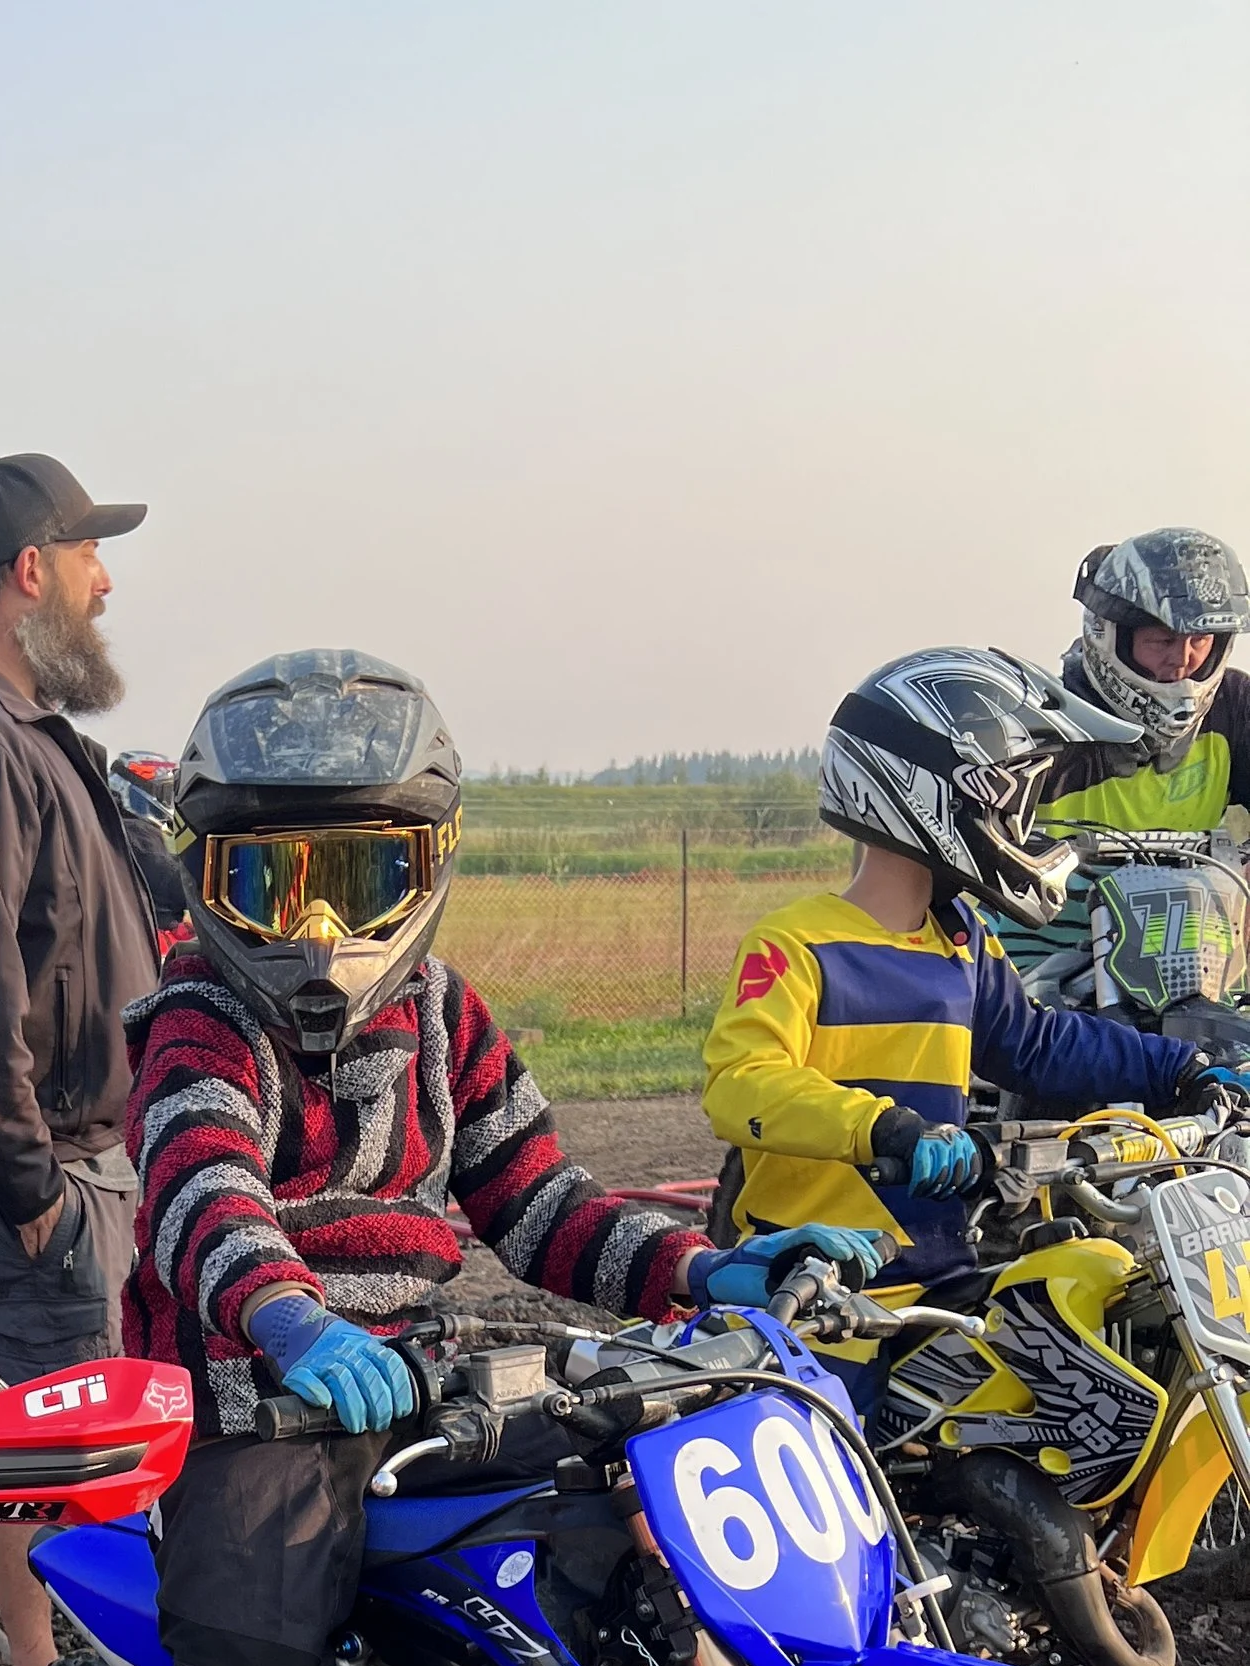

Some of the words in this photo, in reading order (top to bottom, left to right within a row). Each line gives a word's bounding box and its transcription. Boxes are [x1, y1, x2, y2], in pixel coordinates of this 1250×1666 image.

[1180, 1218, 1250, 1258] BRAN
[1068, 1412, 1121, 1454] 65
[674, 1408, 887, 1590] 600
